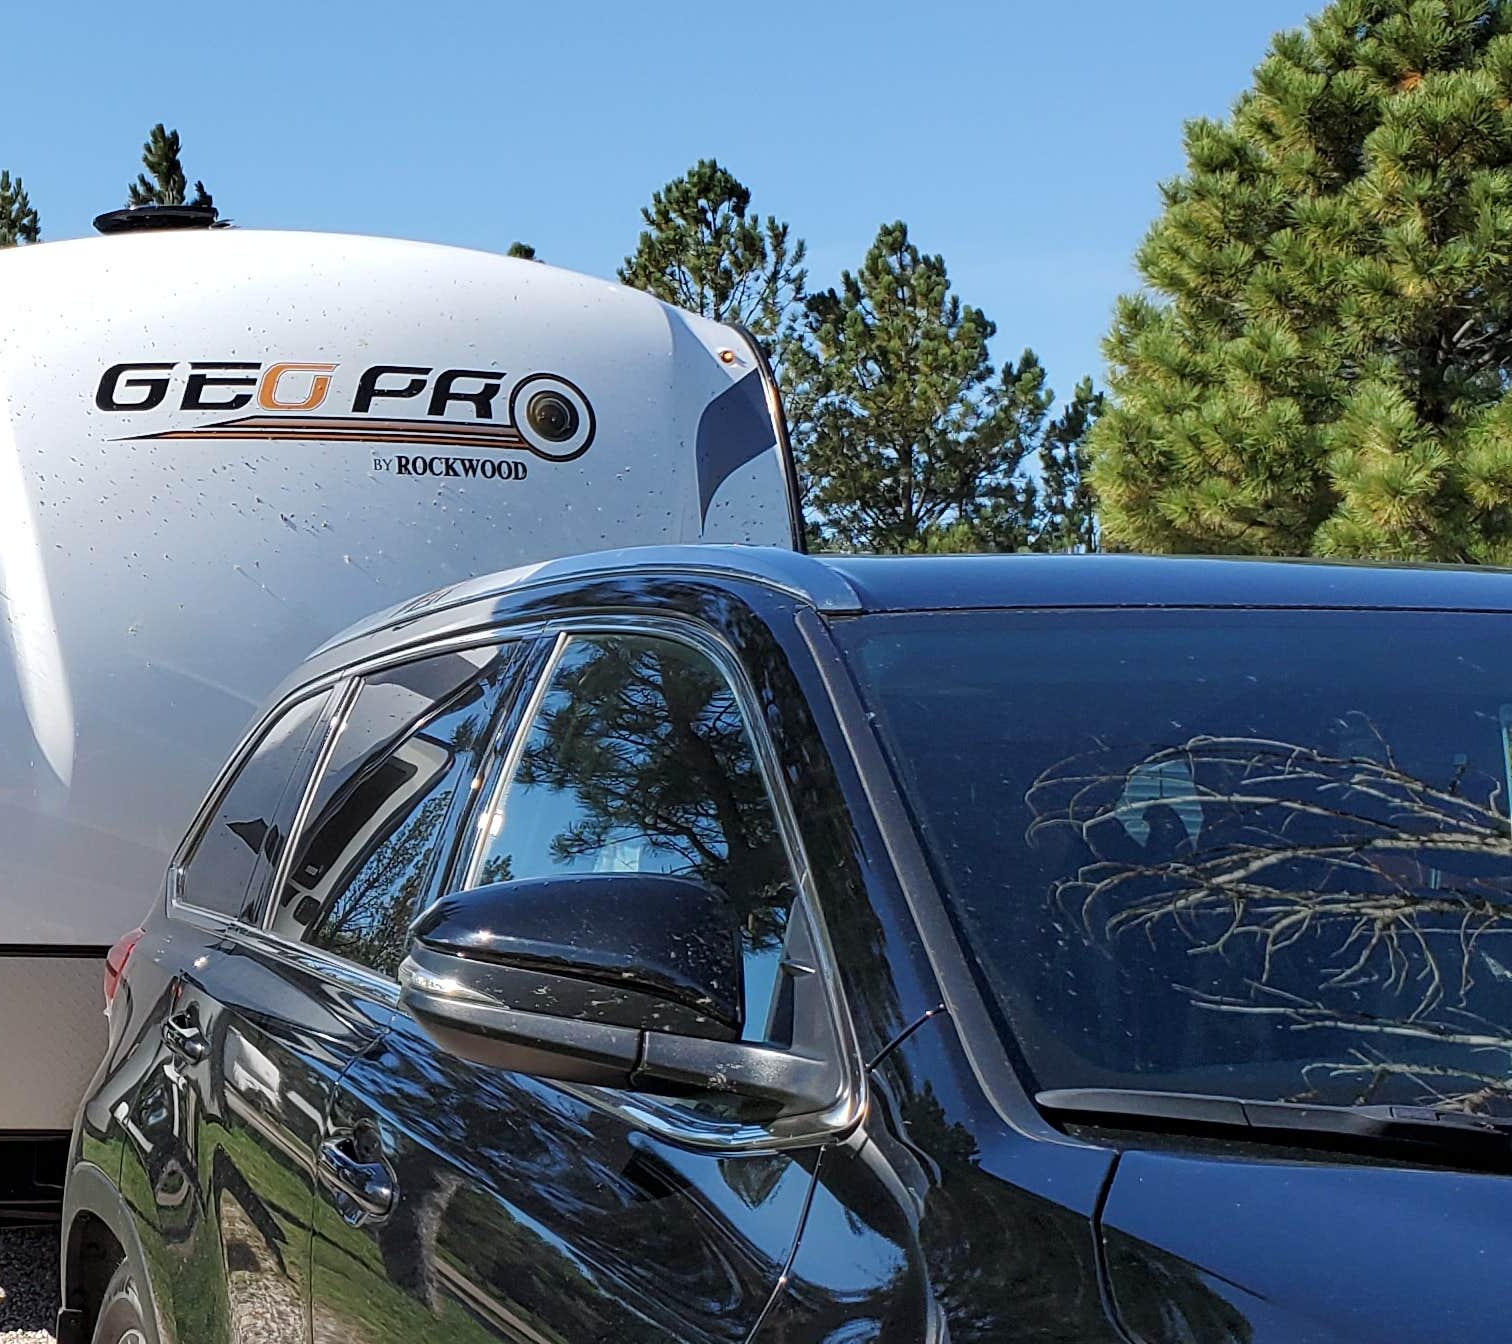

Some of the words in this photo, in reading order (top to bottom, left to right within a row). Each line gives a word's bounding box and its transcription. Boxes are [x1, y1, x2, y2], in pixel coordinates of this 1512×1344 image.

[94, 360, 341, 412] GEO
[351, 365, 597, 462] PRO
[373, 458, 393, 472] BY
[396, 455, 529, 481] ROCKWOOD
